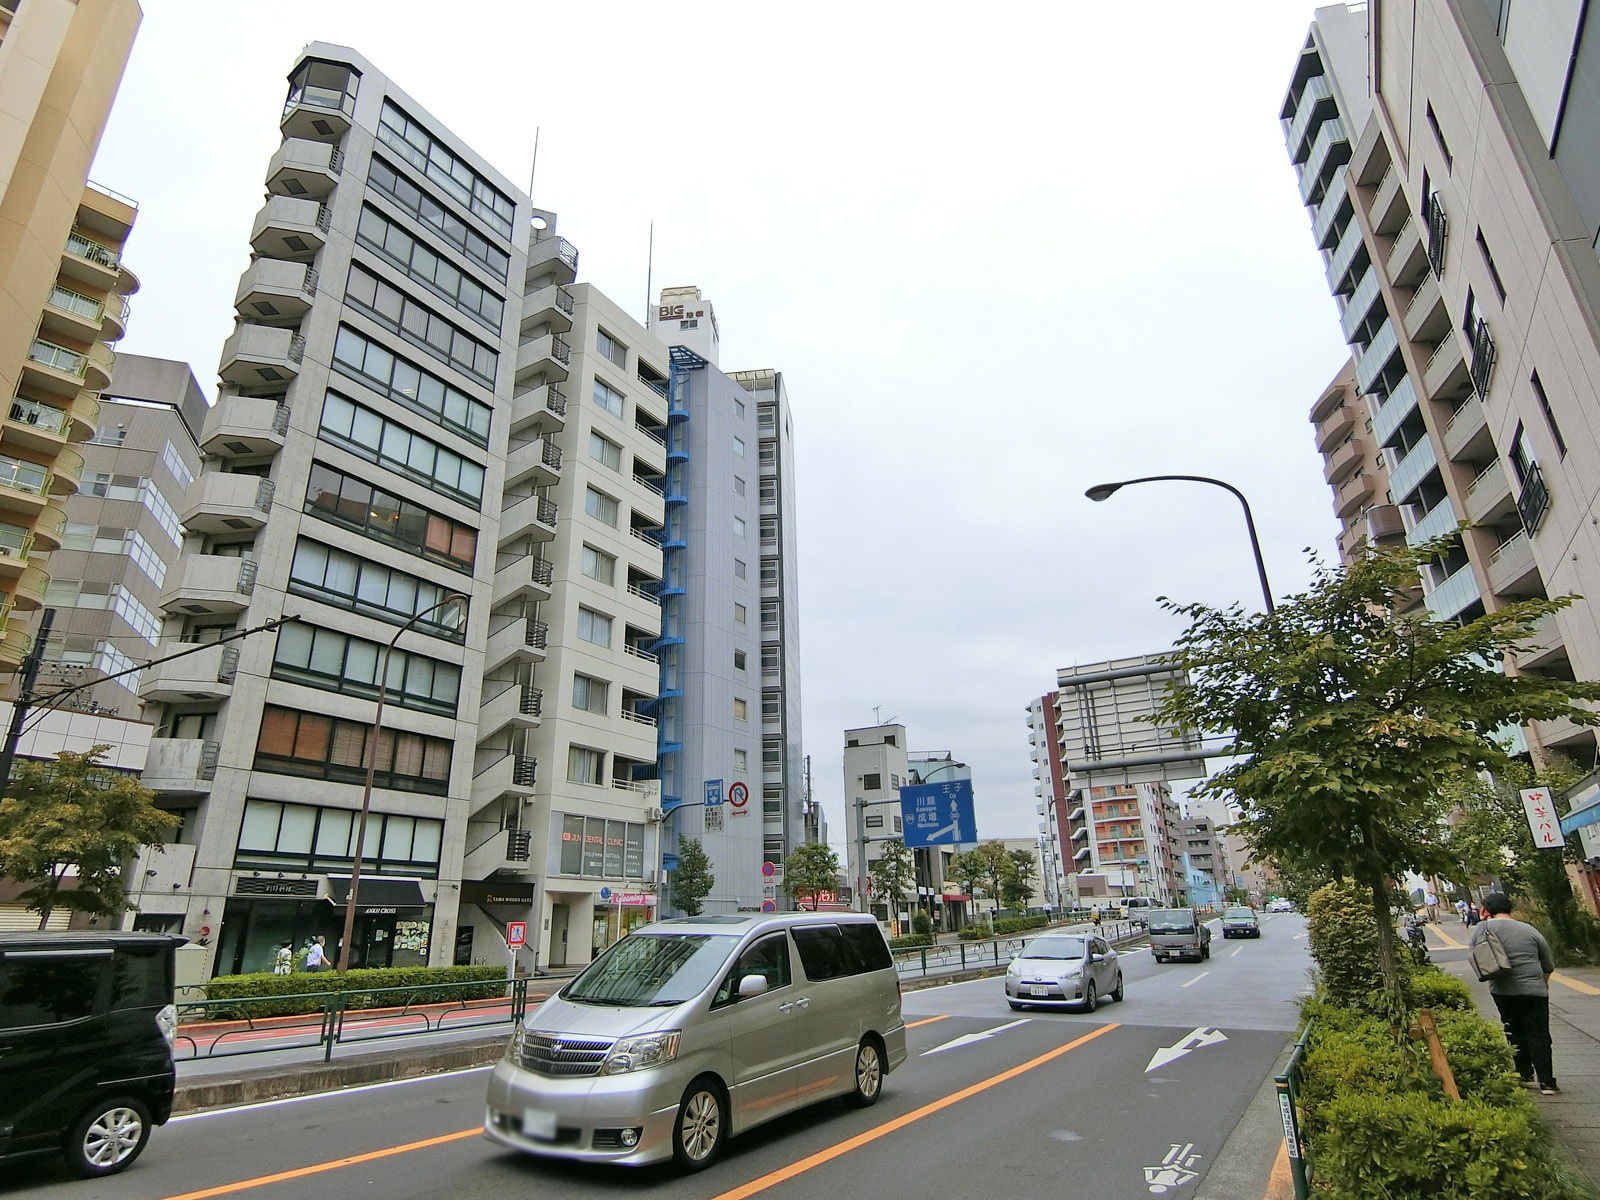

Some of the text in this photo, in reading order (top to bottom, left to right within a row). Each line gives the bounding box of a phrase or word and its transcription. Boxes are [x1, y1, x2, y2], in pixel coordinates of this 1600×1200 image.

[659, 305, 684, 316] BIG
[942, 782, 962, 794] 王子
[916, 796, 936, 806] 川越
[917, 812, 937, 822] 成増
[584, 835, 604, 844] DENTAL
[607, 838, 624, 847] CLINIC
[615, 892, 643, 904] Cleaning
